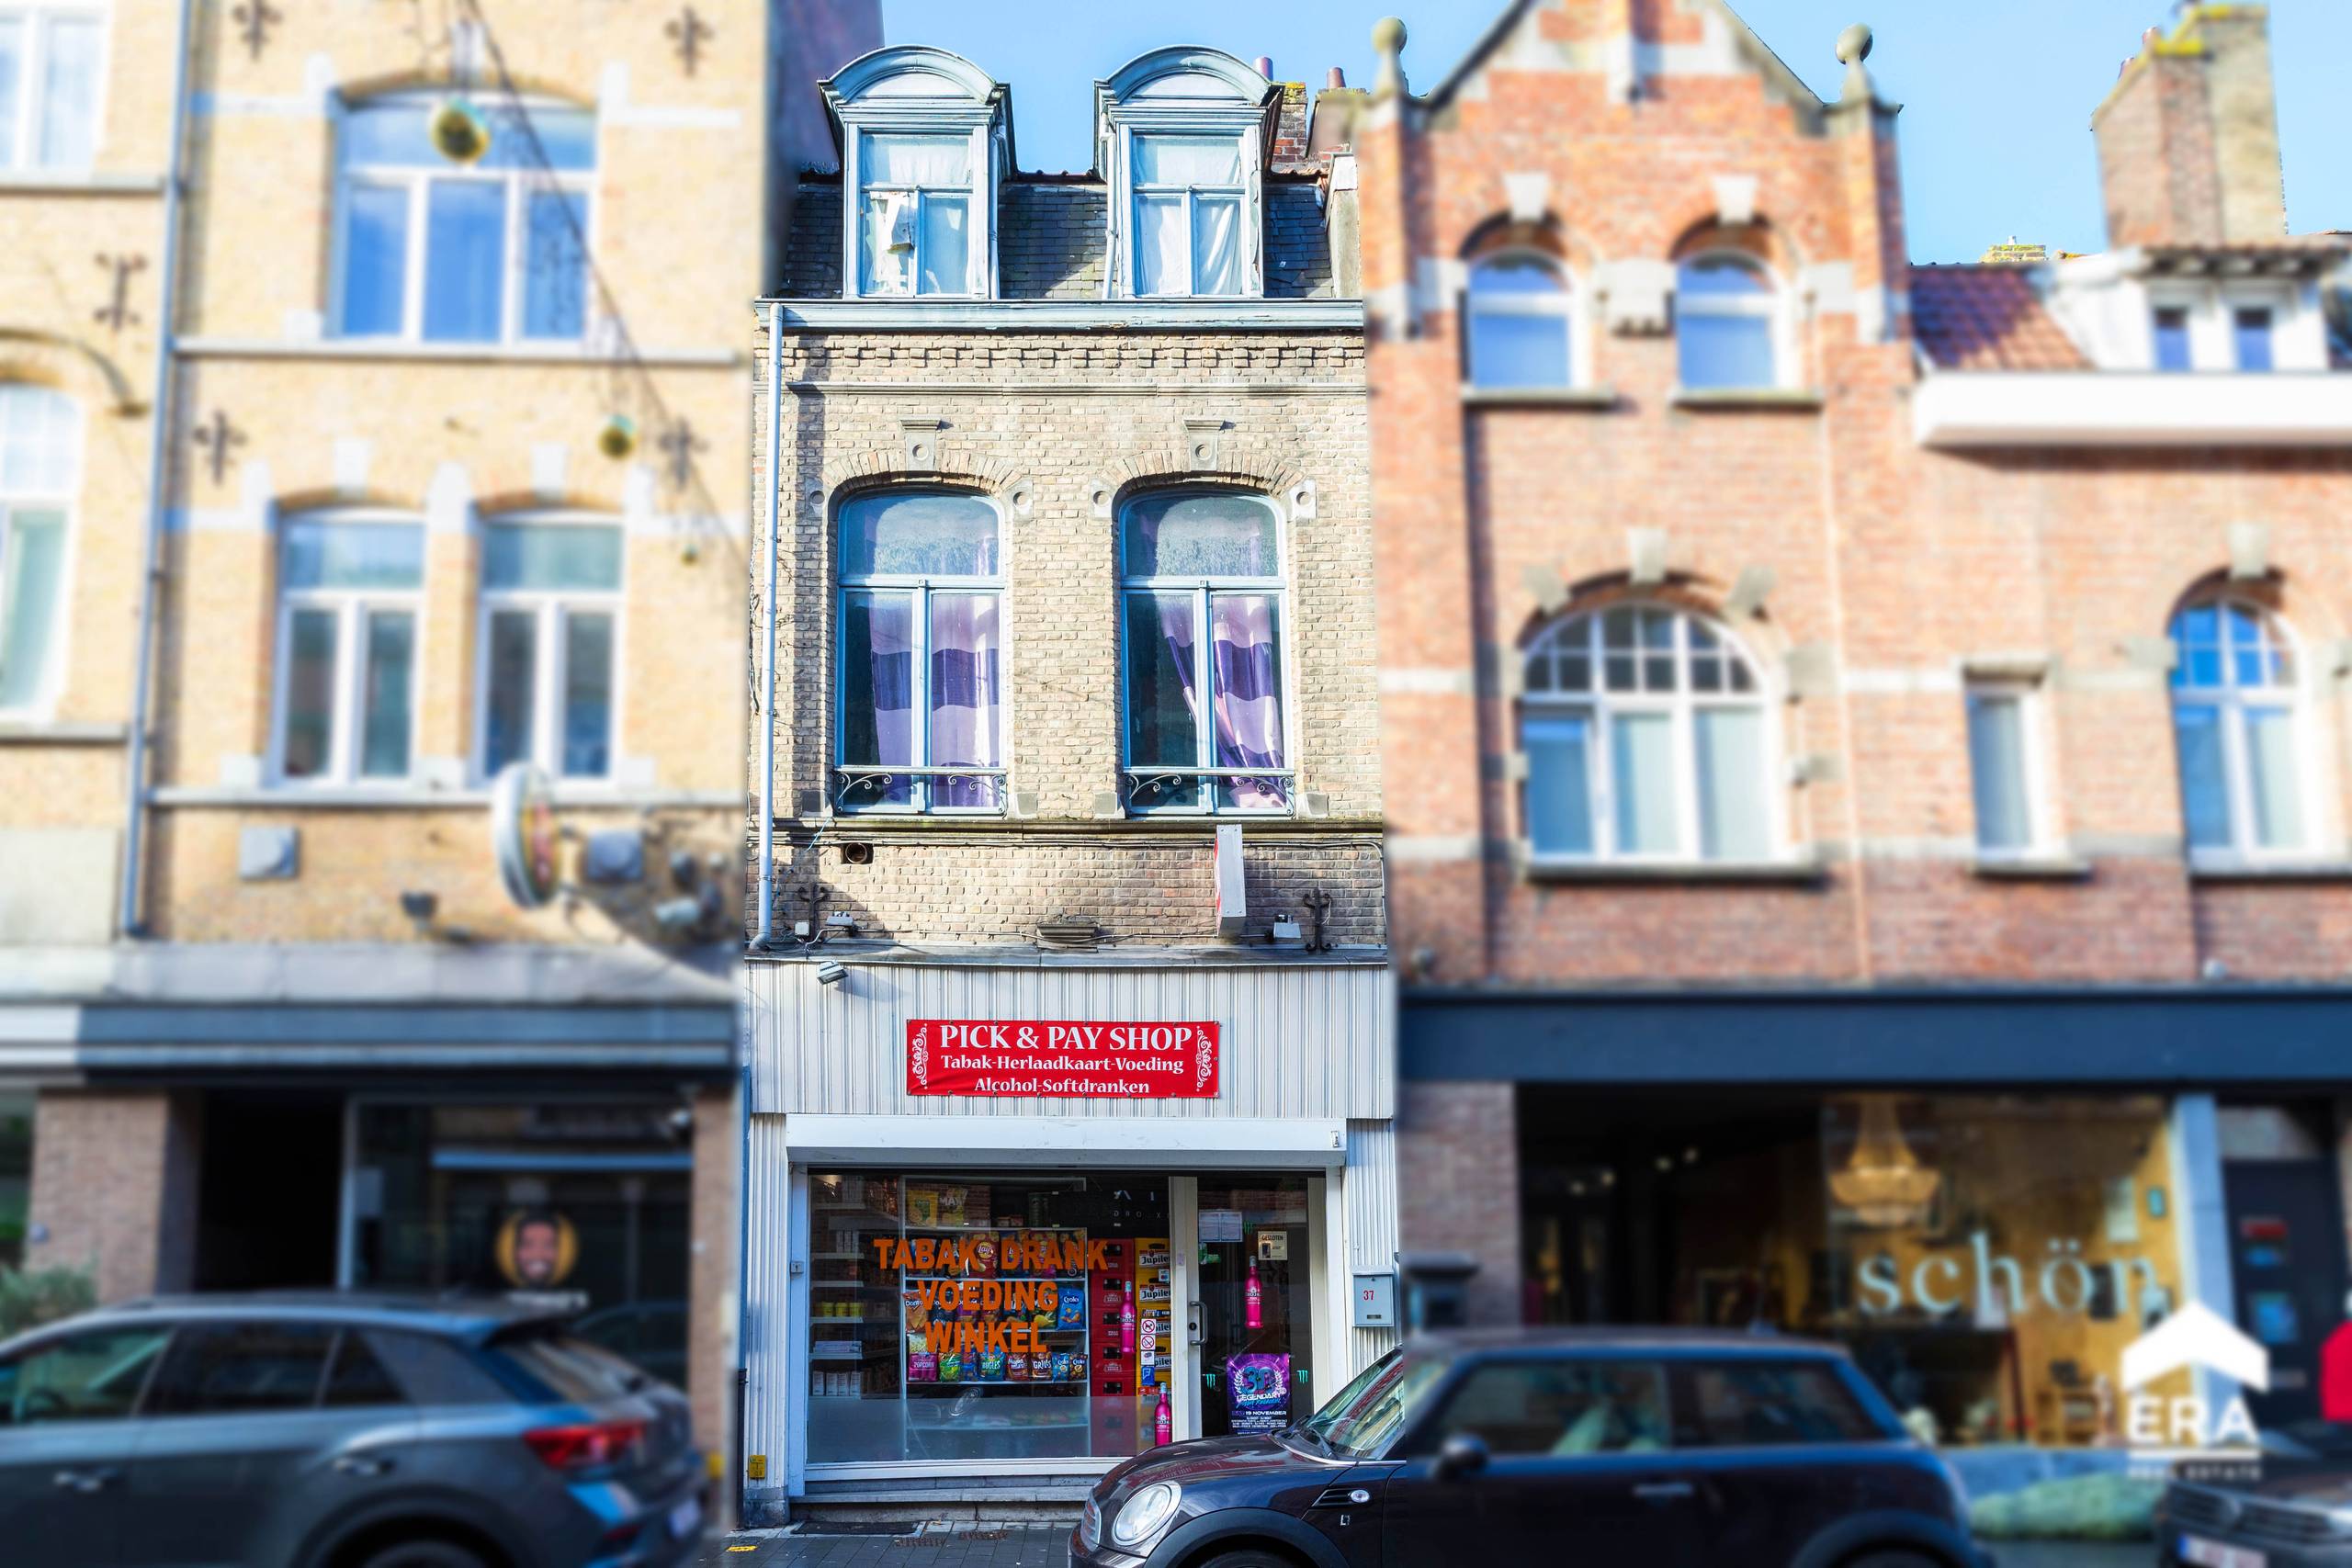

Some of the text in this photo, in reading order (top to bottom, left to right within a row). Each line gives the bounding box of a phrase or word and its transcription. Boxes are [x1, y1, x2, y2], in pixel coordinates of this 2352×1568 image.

[940, 1025, 1193, 1051] PICK & PAY SHOP
[940, 1055, 1184, 1074] Tabak-Herlaadkaart-Voeding
[974, 1077, 1150, 1094] Alcohol-Softdranken
[873, 1238, 1109, 1270] TABAK DRANK
[1857, 1232, 2161, 1314] schön
[917, 1280, 1058, 1312] VOEDING
[1363, 1290, 1374, 1301] 37
[924, 1321, 1047, 1353] WINKEL
[1236, 1392, 1282, 1403] LEGENDARY
